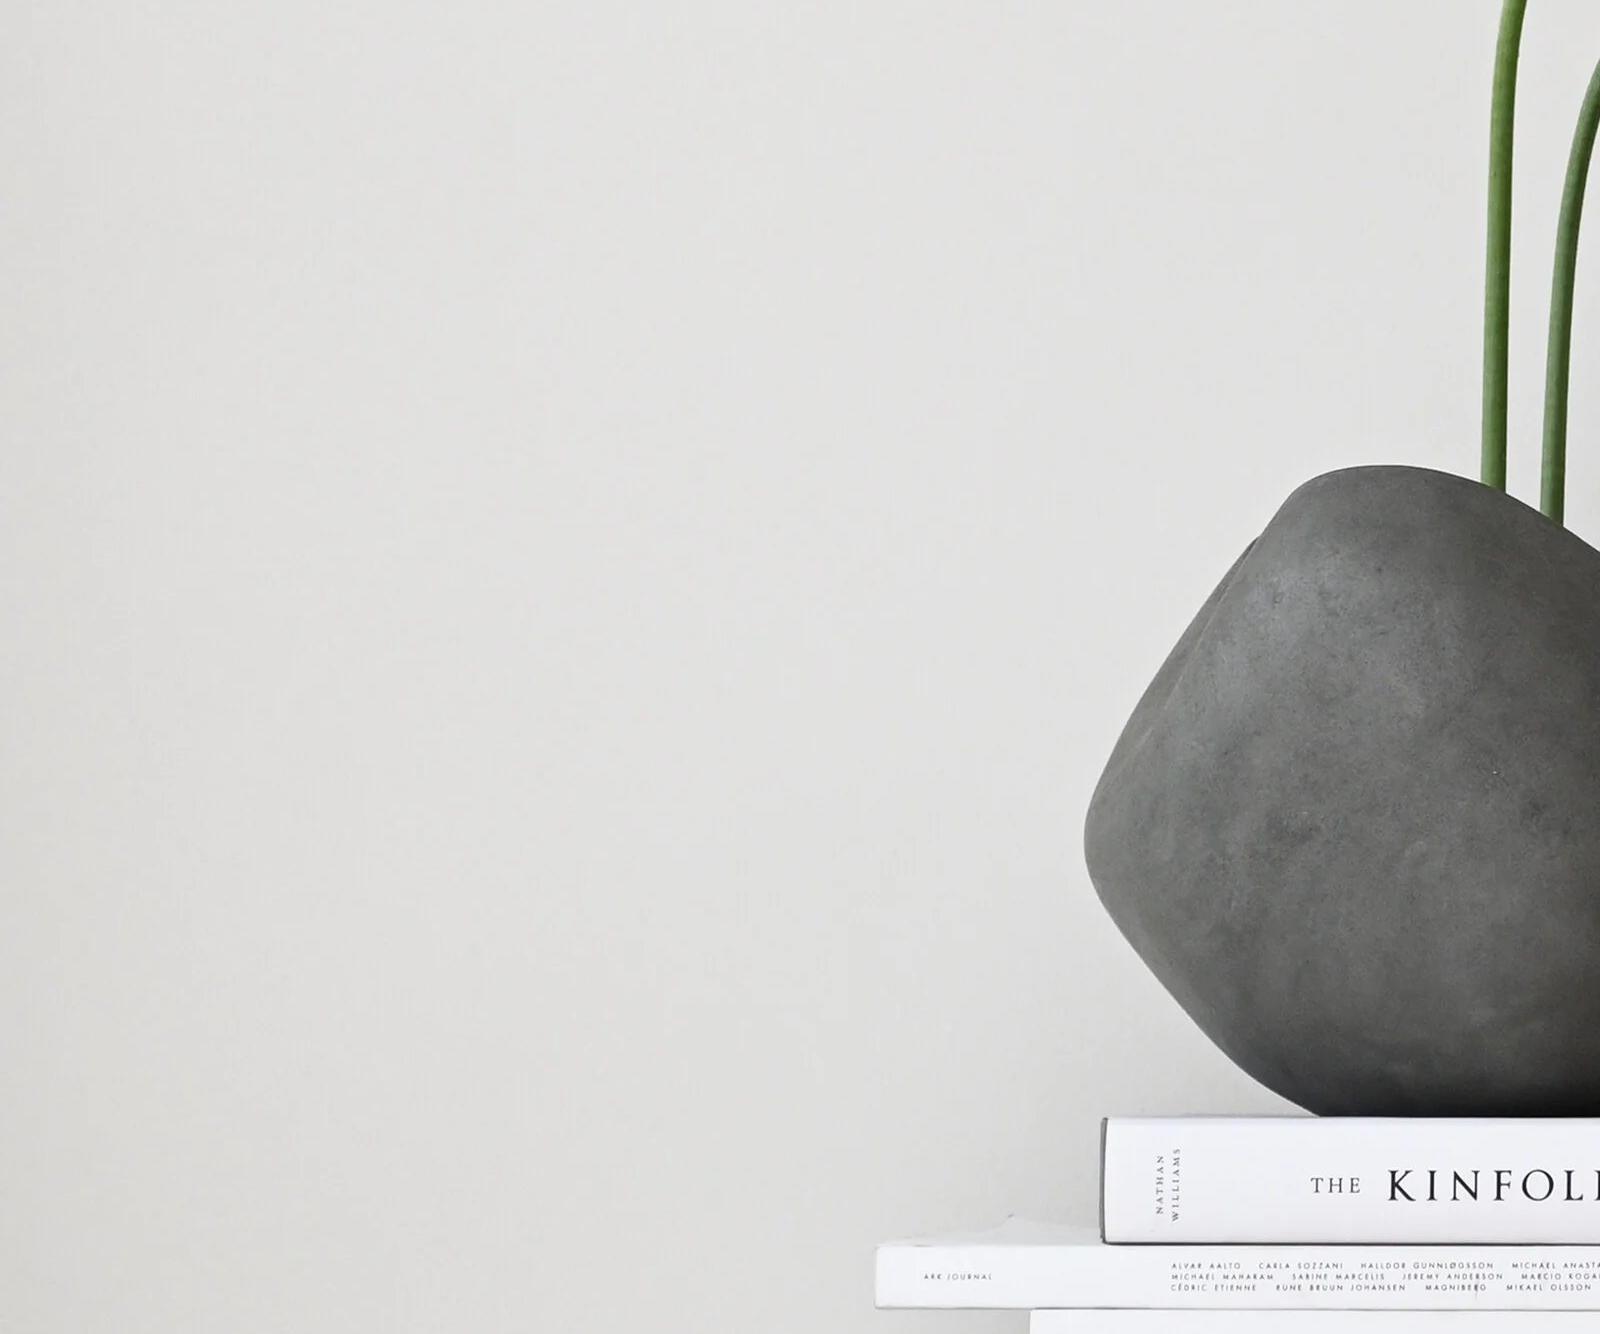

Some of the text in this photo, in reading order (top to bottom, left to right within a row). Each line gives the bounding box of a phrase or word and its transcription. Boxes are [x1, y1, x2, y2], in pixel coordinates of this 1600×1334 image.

[1155, 1155, 1165, 1215] NATHAN
[1171, 1148, 1181, 1222] WILLIAMS
[1309, 1177, 1361, 1194] THE
[1171, 1262, 1202, 1270] ALVAR
[1208, 1262, 1241, 1270] AALTO
[1258, 1262, 1291, 1270] CARLA
[1297, 1261, 1343, 1270] SOZZANI
[1360, 1261, 1406, 1270] HALLDOR
[1511, 1261, 1556, 1270] MICHAEL
[923, 1273, 992, 1281] ARK JOURNAL
[1171, 1273, 1215, 1281] MICHAEL
[1222, 1273, 1274, 1281] MAHARAM
[1291, 1272, 1328, 1281] SABINE
[1335, 1272, 1385, 1281] MARCELIS
[1402, 1272, 1440, 1281] JEREMY
[1446, 1272, 1503, 1281] ANDERSON
[1520, 1272, 1562, 1281] MARCIO
[1170, 1282, 1207, 1292] CÉDRIC
[1214, 1283, 1256, 1292] ETIENNE
[1275, 1283, 1302, 1292] RUNE
[1309, 1283, 1344, 1292] BRUUN
[1350, 1283, 1406, 1292] JOHANSEN
[1425, 1282, 1487, 1292] MAGNIBERG
[1505, 1283, 1543, 1292] MIKAEL
[1550, 1283, 1592, 1292] OLSSON
